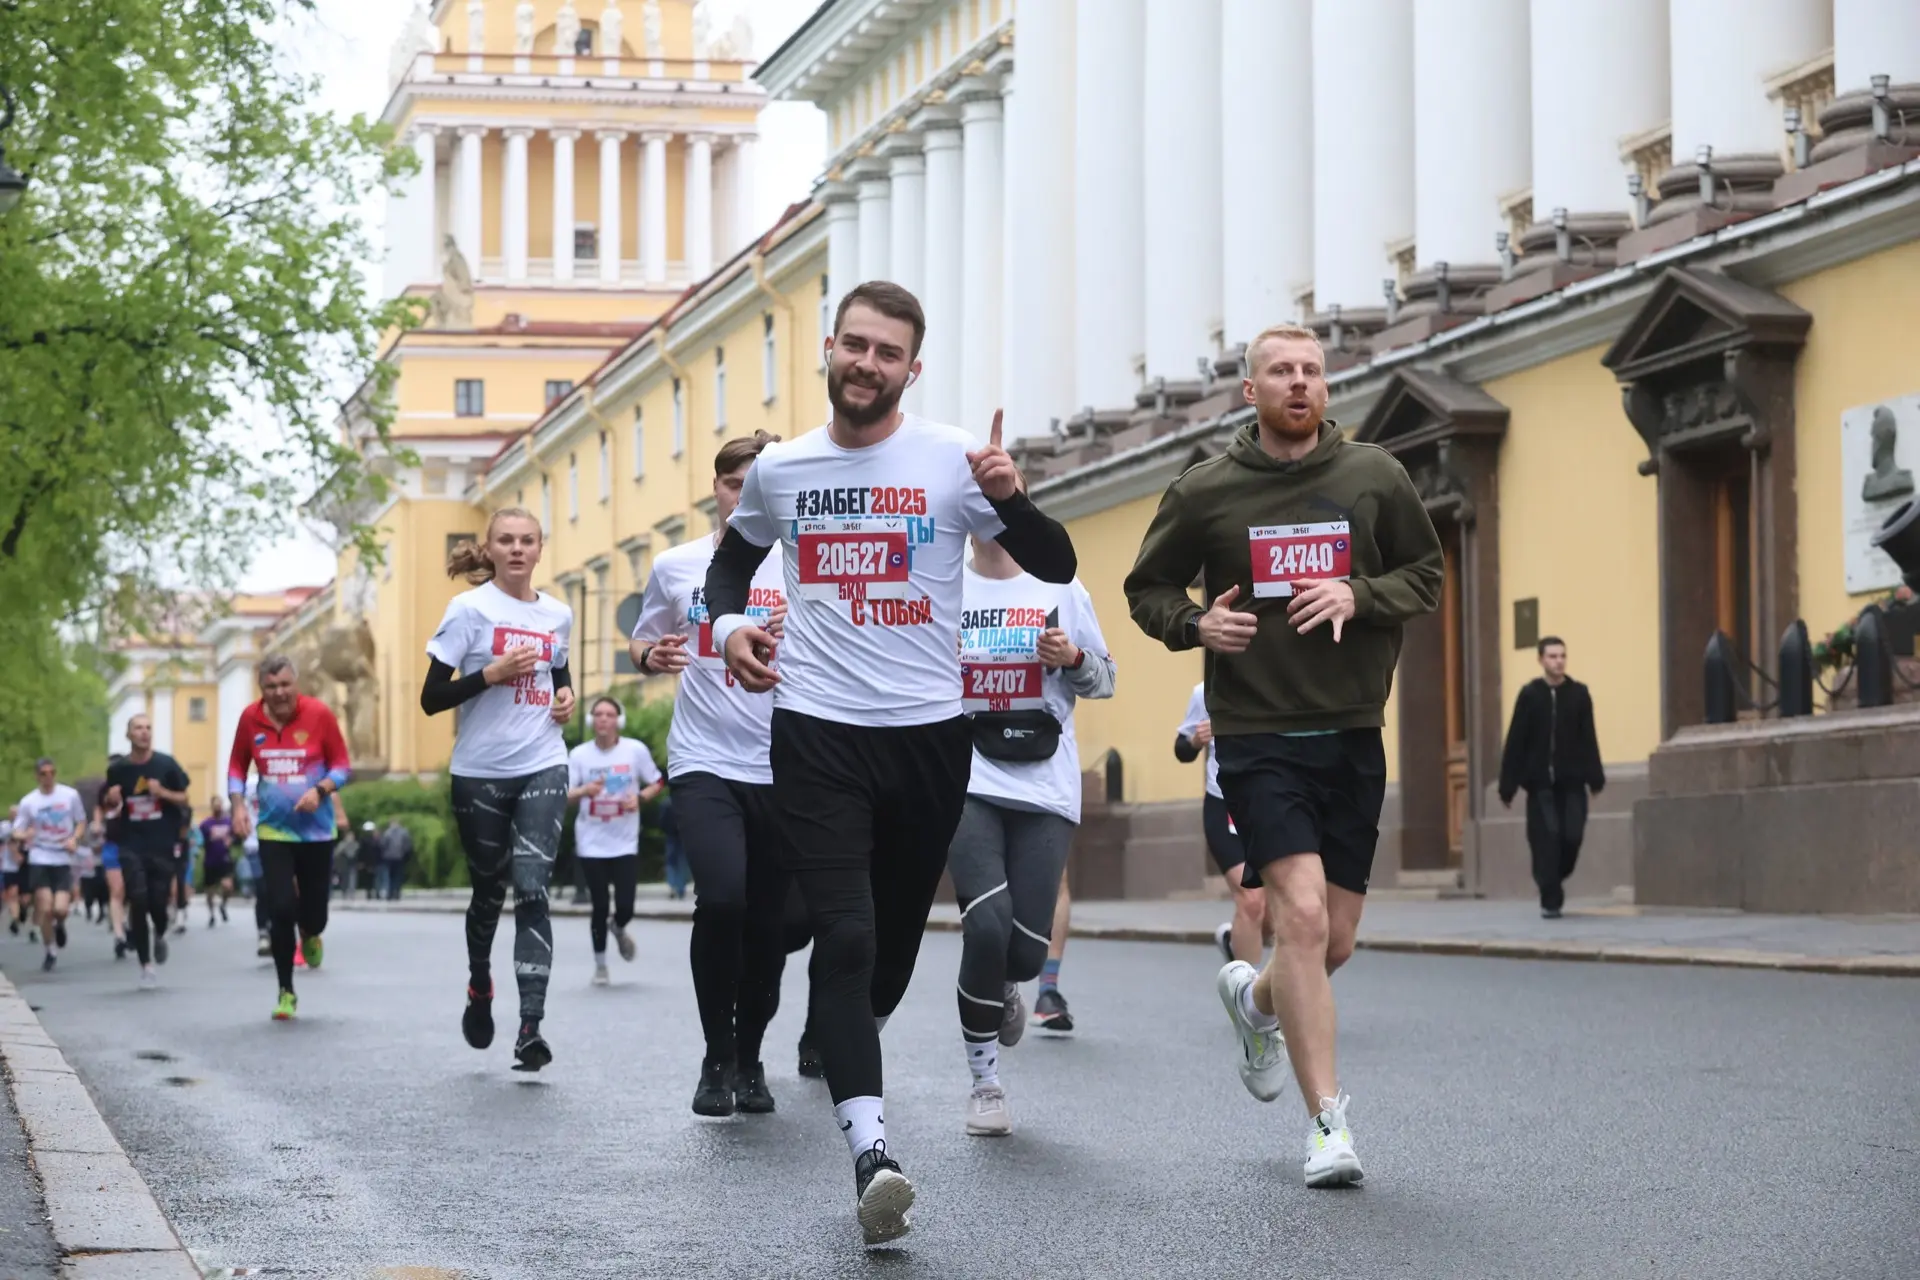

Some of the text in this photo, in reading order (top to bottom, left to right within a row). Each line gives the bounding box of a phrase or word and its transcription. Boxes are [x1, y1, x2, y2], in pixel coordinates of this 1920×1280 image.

[796, 487, 927, 517] #ЗАБЕГ2025
[817, 542, 888, 576] 20527
[1270, 542, 1334, 575] 24740
[869, 596, 933, 626] ТОБОЙ
[961, 608, 1046, 630] ЗАБЕГ2025
[972, 669, 1026, 694] 24707
